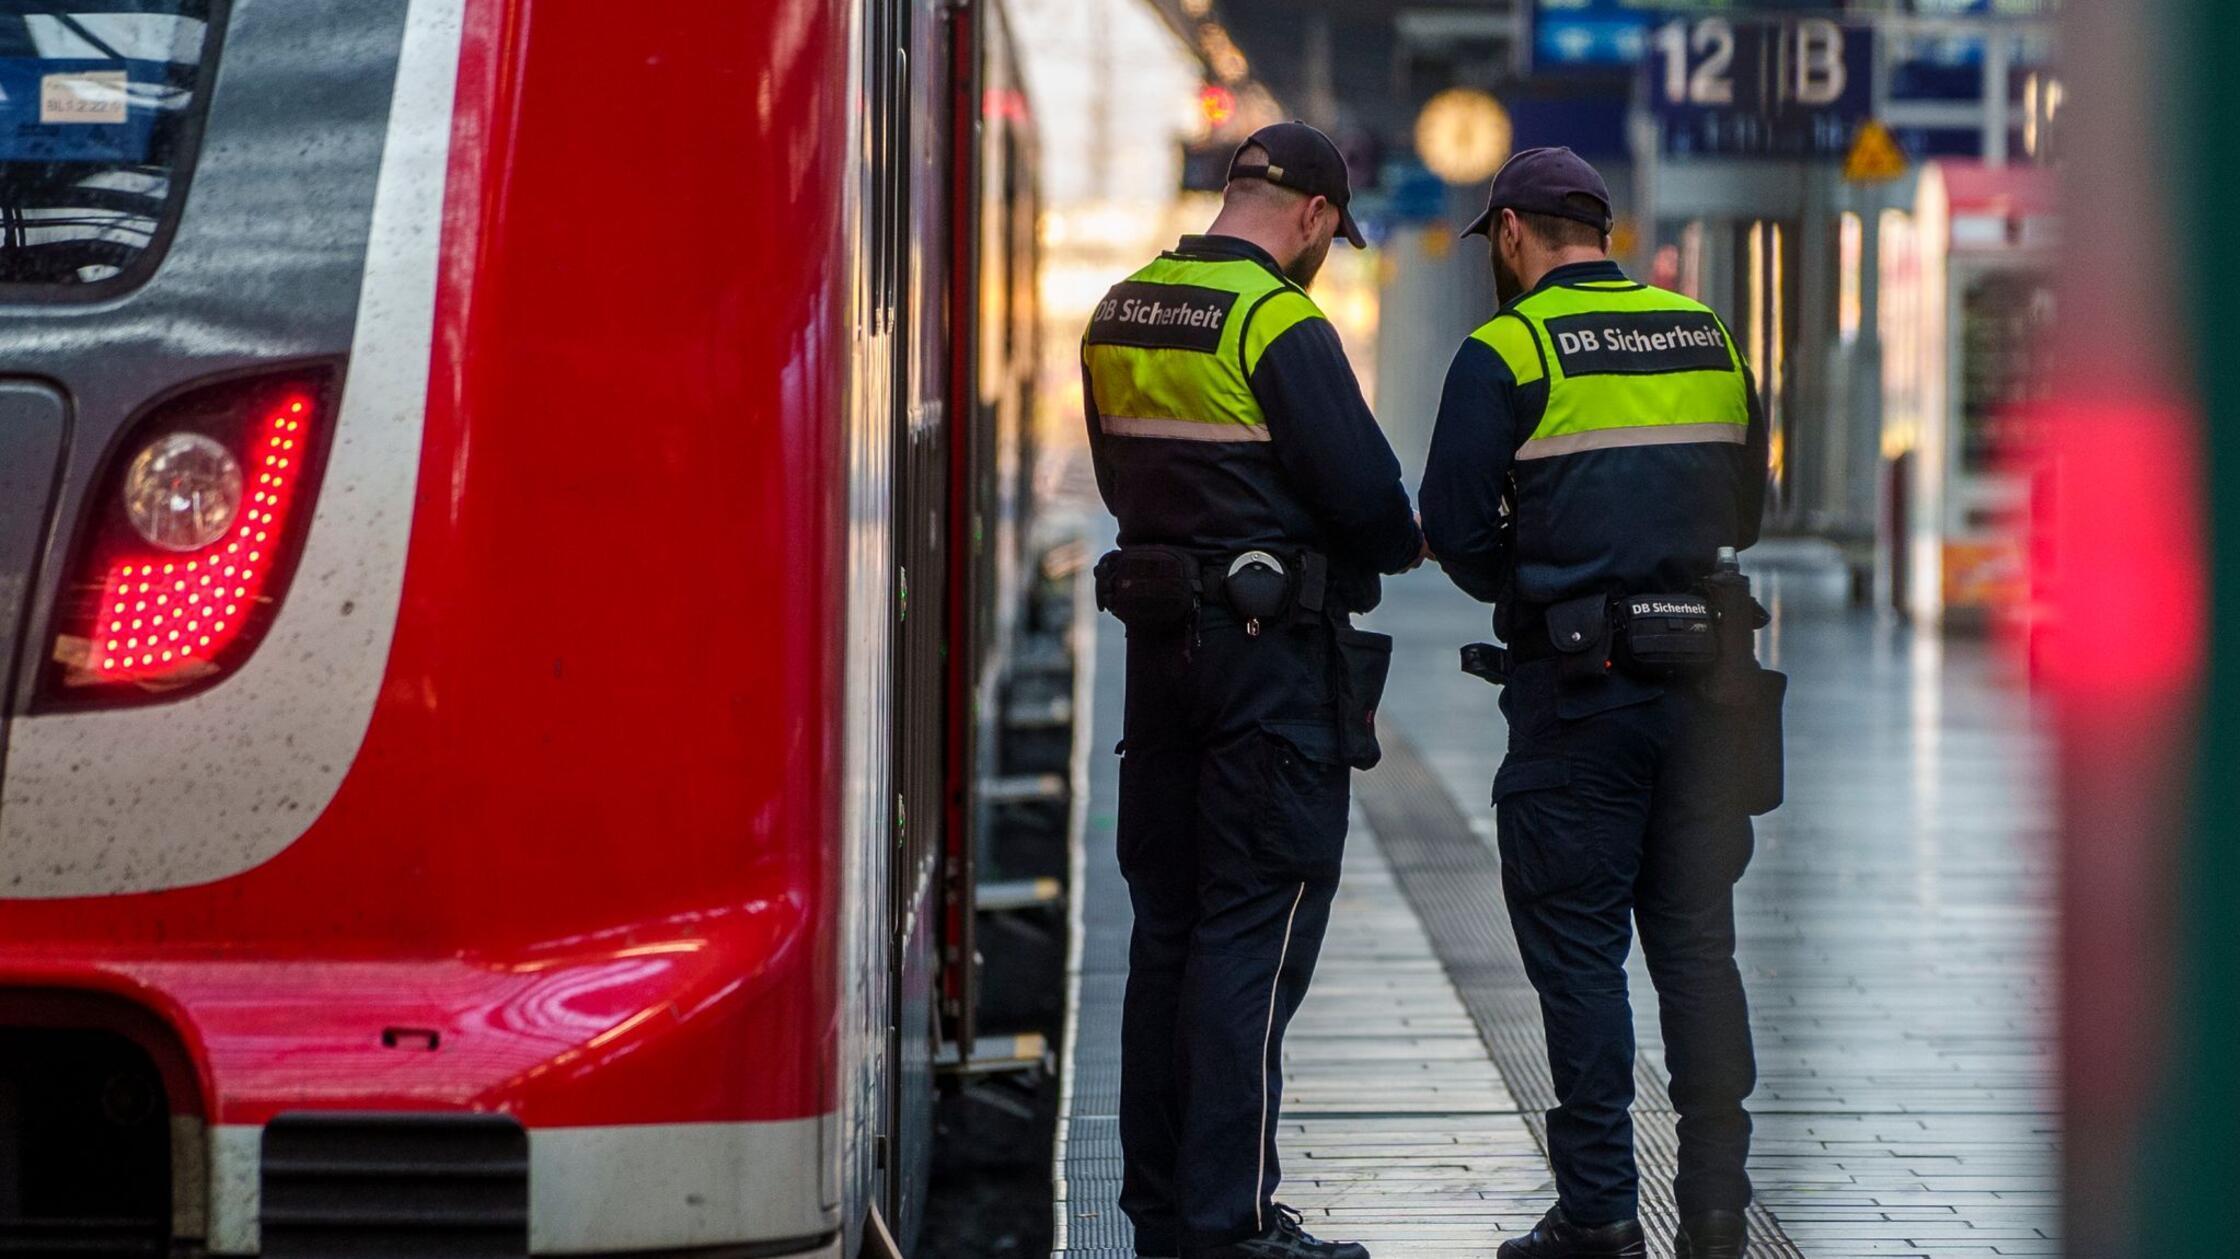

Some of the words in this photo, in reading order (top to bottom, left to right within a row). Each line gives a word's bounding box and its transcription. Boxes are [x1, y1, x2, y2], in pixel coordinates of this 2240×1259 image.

[1653, 17, 1734, 104] 12
[1798, 17, 1848, 104] B
[1094, 299, 1118, 322] DB
[1119, 298, 1223, 330] Sicherheit
[1558, 329, 1600, 355] DB
[1603, 325, 1725, 353] Sicherheit
[1632, 603, 1651, 615] DB
[1652, 602, 1707, 614] Sicherheit
